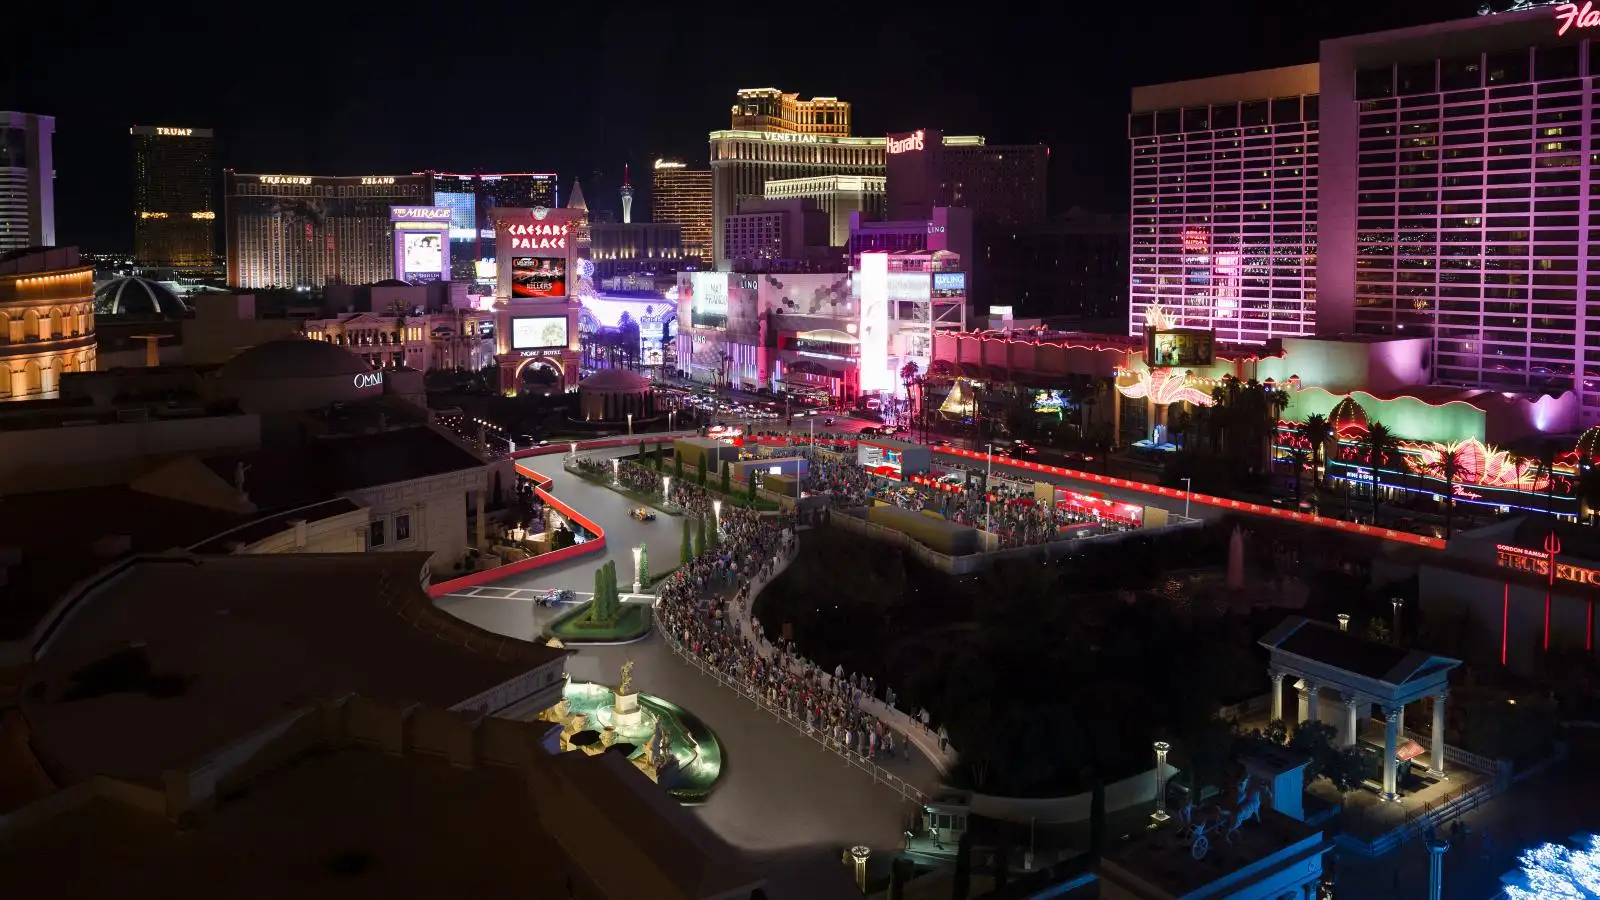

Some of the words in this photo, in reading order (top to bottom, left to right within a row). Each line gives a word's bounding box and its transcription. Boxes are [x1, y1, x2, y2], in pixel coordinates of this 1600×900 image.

[156, 127, 193, 136] TRUMP
[764, 131, 817, 143] VENETIAN
[886, 130, 925, 154] Harrah's
[260, 175, 313, 185] TREASURE
[361, 177, 395, 185] ISLAND
[400, 208, 451, 218] MIRAGE
[508, 224, 568, 236] CAESARS
[927, 226, 945, 234] LINQ
[512, 237, 566, 249] PALACE
[741, 280, 758, 290] LINQ
[1452, 484, 1483, 500] Flamingo
[1497, 544, 1524, 554] GORDON
[1524, 549, 1550, 559] RAMSAY
